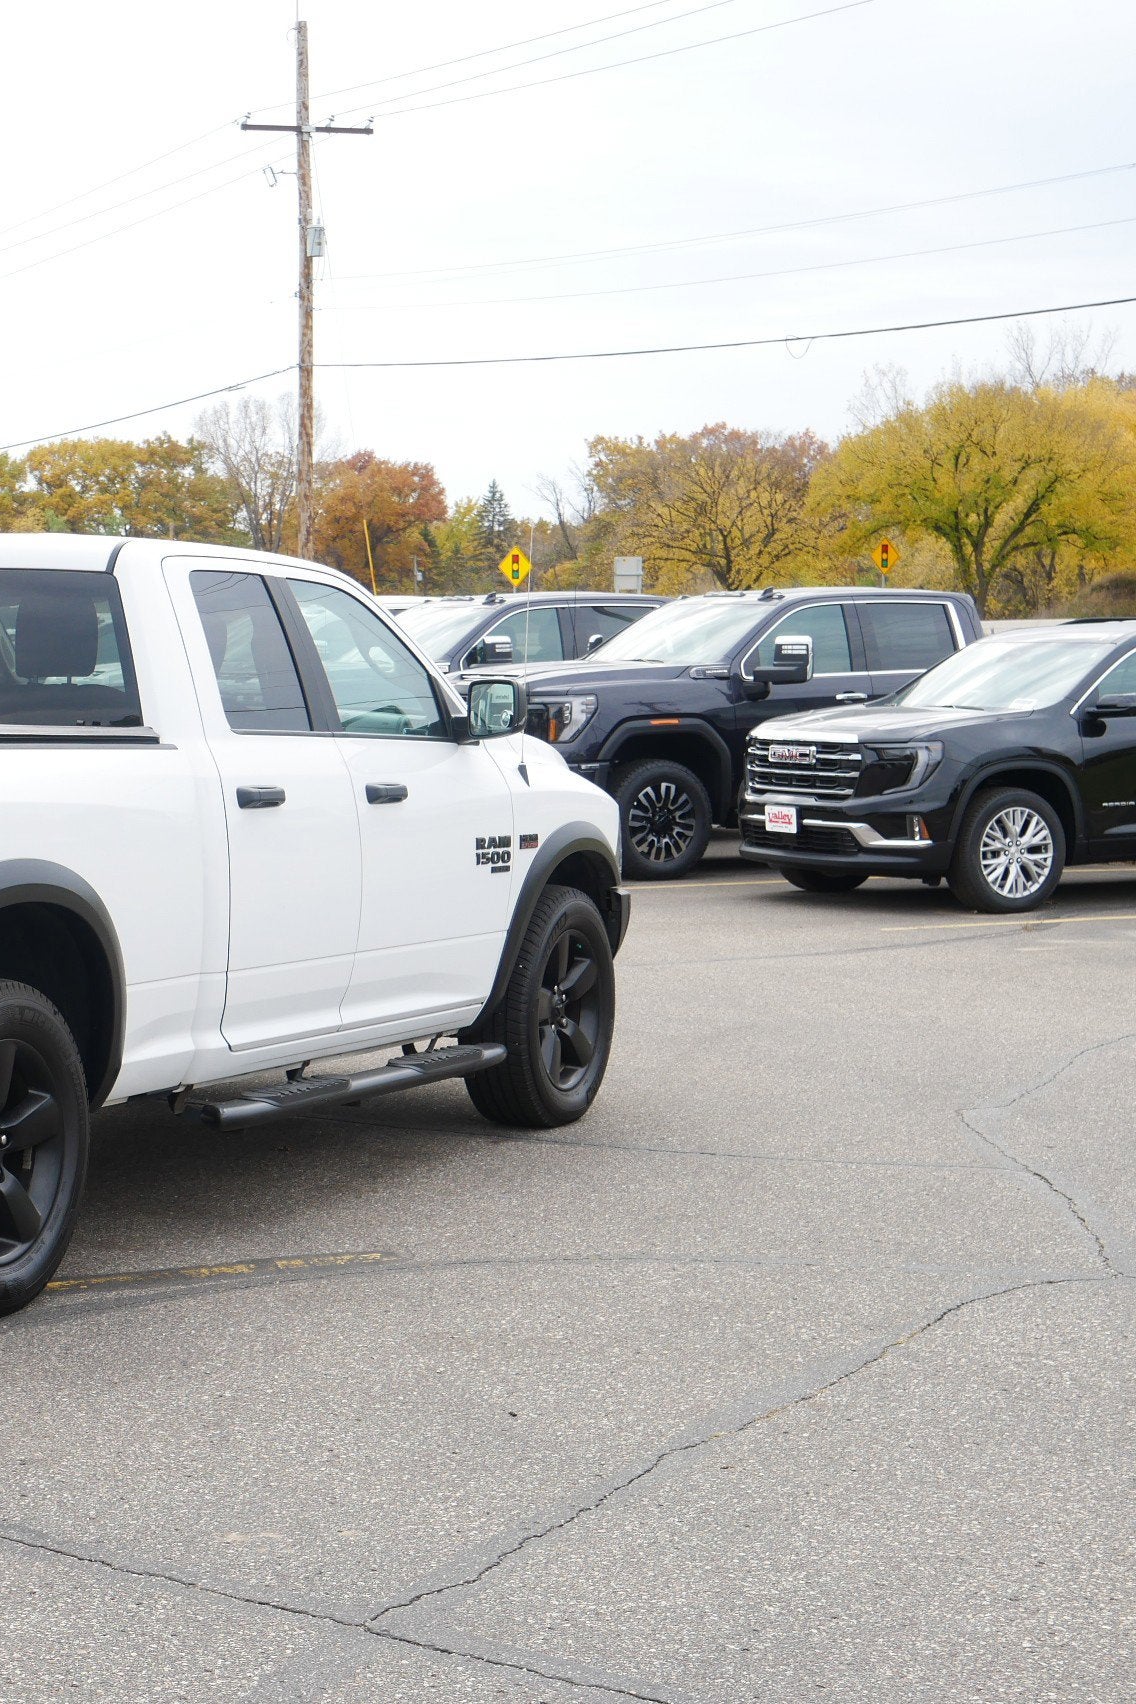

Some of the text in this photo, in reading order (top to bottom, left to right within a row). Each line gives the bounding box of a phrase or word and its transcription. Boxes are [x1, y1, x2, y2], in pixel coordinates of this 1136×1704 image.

[770, 747, 811, 763] GMC
[475, 835, 511, 850] RAM
[475, 850, 511, 865] 1500
